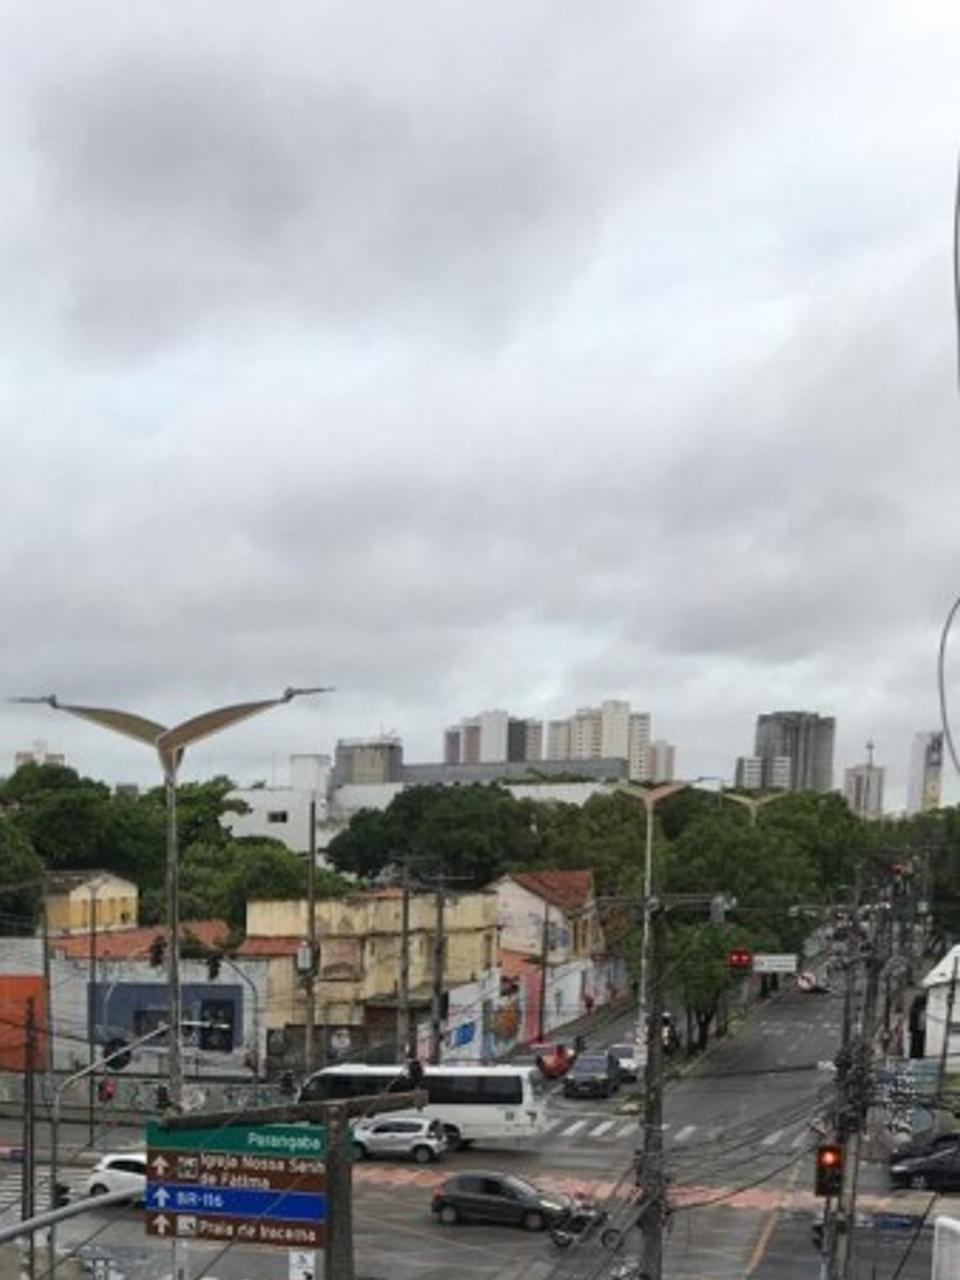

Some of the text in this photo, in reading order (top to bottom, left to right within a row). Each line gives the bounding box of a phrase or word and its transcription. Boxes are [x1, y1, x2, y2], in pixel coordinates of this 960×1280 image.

[248, 1132, 321, 1150] Parangaba
[200, 1153, 326, 1174] Igreja Nossa Senh
[200, 1171, 215, 1185] de
[176, 1191, 224, 1208] BR-116
[199, 1219, 316, 1242] Praia de Iracema
